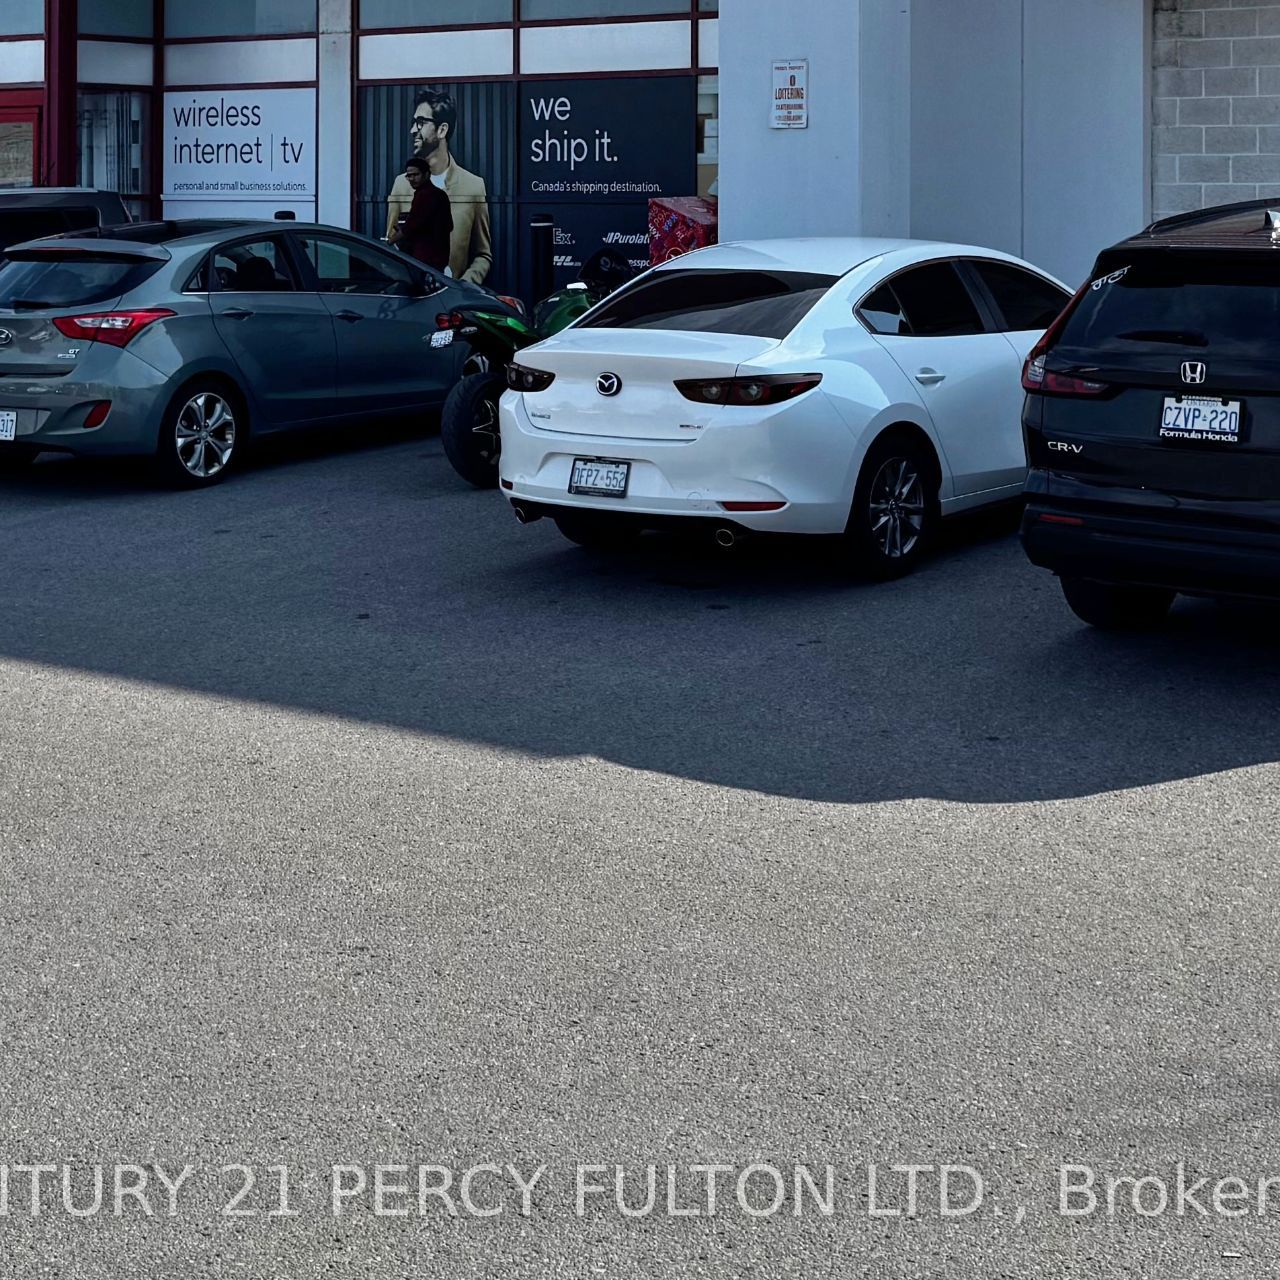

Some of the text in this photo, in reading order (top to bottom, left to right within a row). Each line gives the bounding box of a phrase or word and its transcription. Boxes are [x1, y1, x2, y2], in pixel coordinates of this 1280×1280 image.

[173, 97, 261, 127] wireless
[530, 97, 571, 121] we
[174, 136, 303, 164] internet tv
[531, 129, 618, 171] ship it.
[173, 181, 205, 192] personal
[205, 181, 219, 190] and
[220, 181, 239, 190] small
[240, 181, 271, 191] business
[531, 180, 662, 194] Canada's shipping destination.
[1163, 406, 1238, 432] CZVP 220
[1160, 428, 1238, 442] Formula Honda
[605, 470, 626, 489] 552
